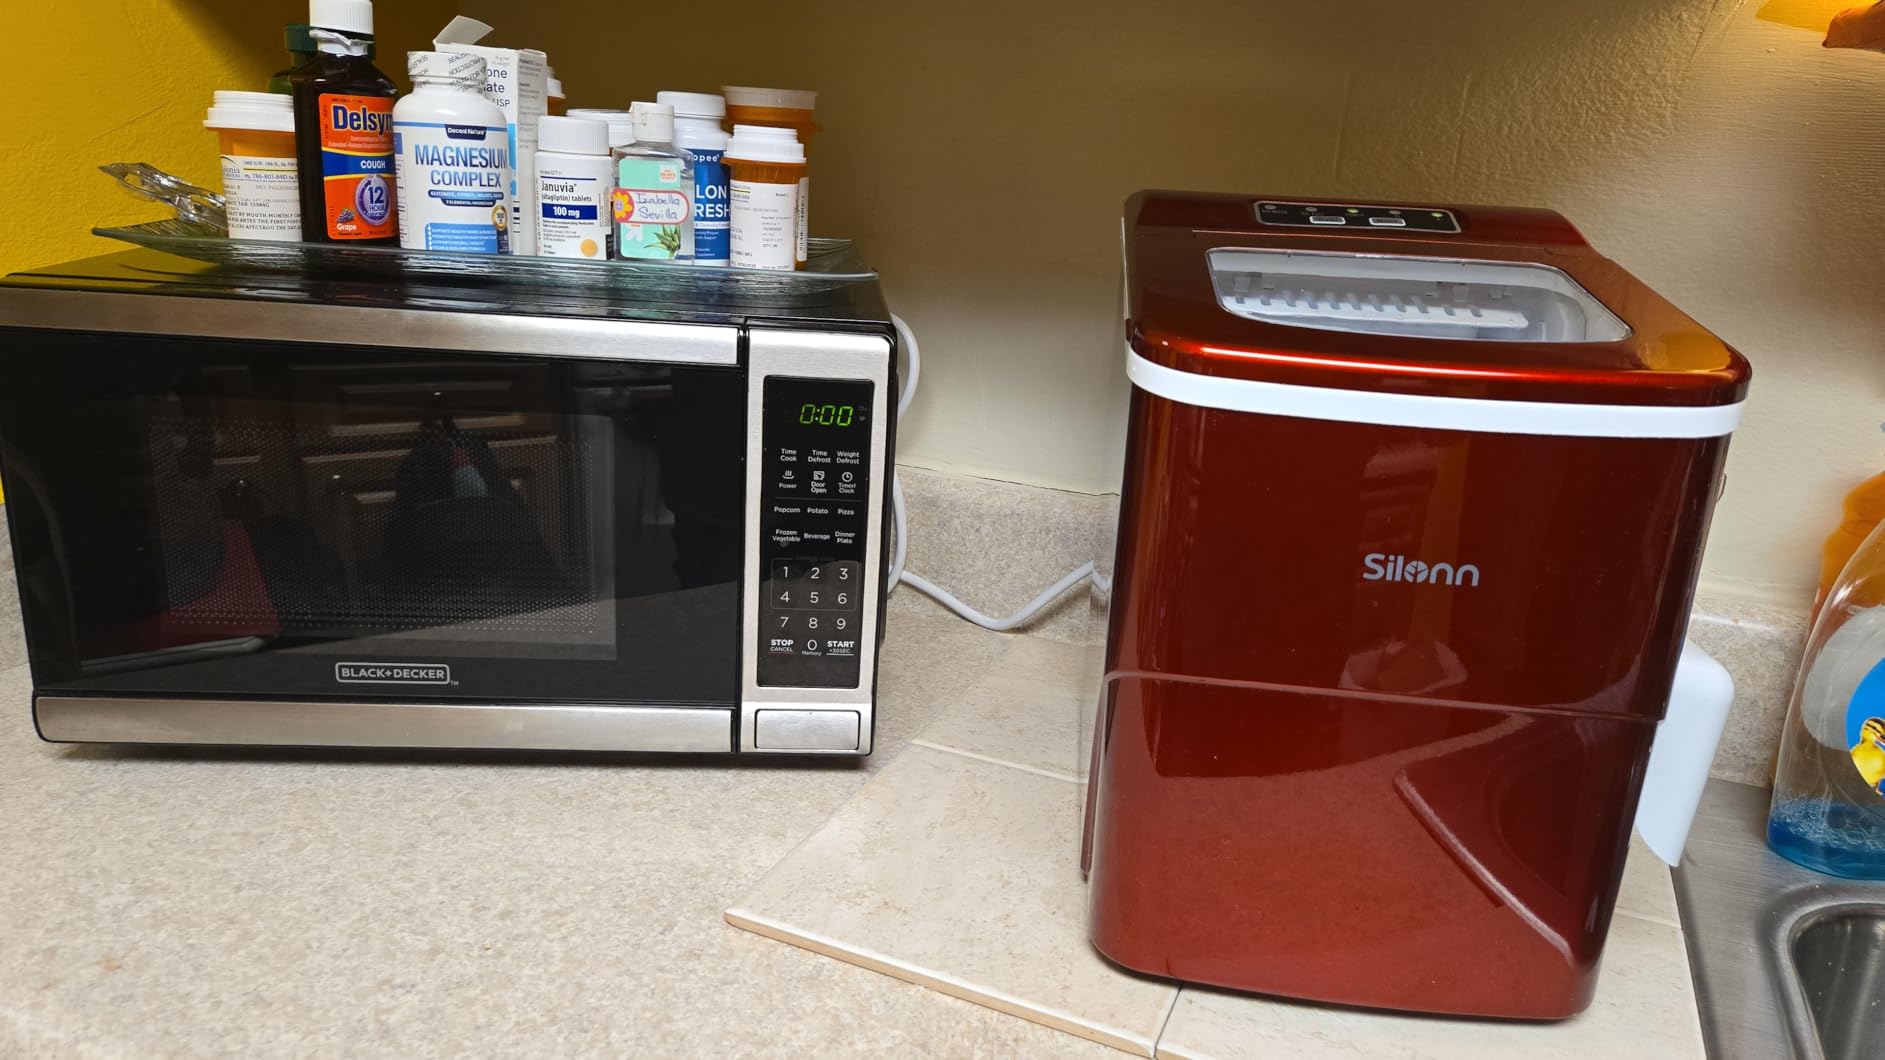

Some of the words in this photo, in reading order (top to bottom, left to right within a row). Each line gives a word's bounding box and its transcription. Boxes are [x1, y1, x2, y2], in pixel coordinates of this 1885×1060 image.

[414, 143, 508, 169] MAGNESIUM
[360, 160, 386, 169] COUGH
[430, 169, 502, 188] COMPLEX
[541, 181, 574, 193] Januvia
[368, 186, 384, 205] 12
[553, 206, 567, 216] 100
[568, 209, 580, 218] mg
[638, 206, 678, 220] Sevilla
[336, 223, 357, 232] Grape
[800, 404, 854, 426] 0:00
[774, 506, 800, 514] Popcorn
[807, 507, 829, 515] Potato
[837, 508, 855, 516] Pizza
[775, 528, 798, 536] Frozen
[803, 532, 831, 541] Beverage
[772, 535, 801, 543] Vegetable
[783, 566, 789, 578] 1
[810, 567, 820, 579] 2
[839, 567, 848, 580] 3
[1363, 552, 1480, 587] Silonn
[780, 591, 790, 603] 4
[809, 591, 819, 604] 5
[837, 592, 848, 605] 6
[780, 616, 789, 628] 7
[808, 617, 818, 629] 8
[836, 618, 846, 630] 9
[770, 639, 794, 647] STOP
[827, 640, 855, 648] START
[341, 667, 445, 679] BLACK+DECKER
